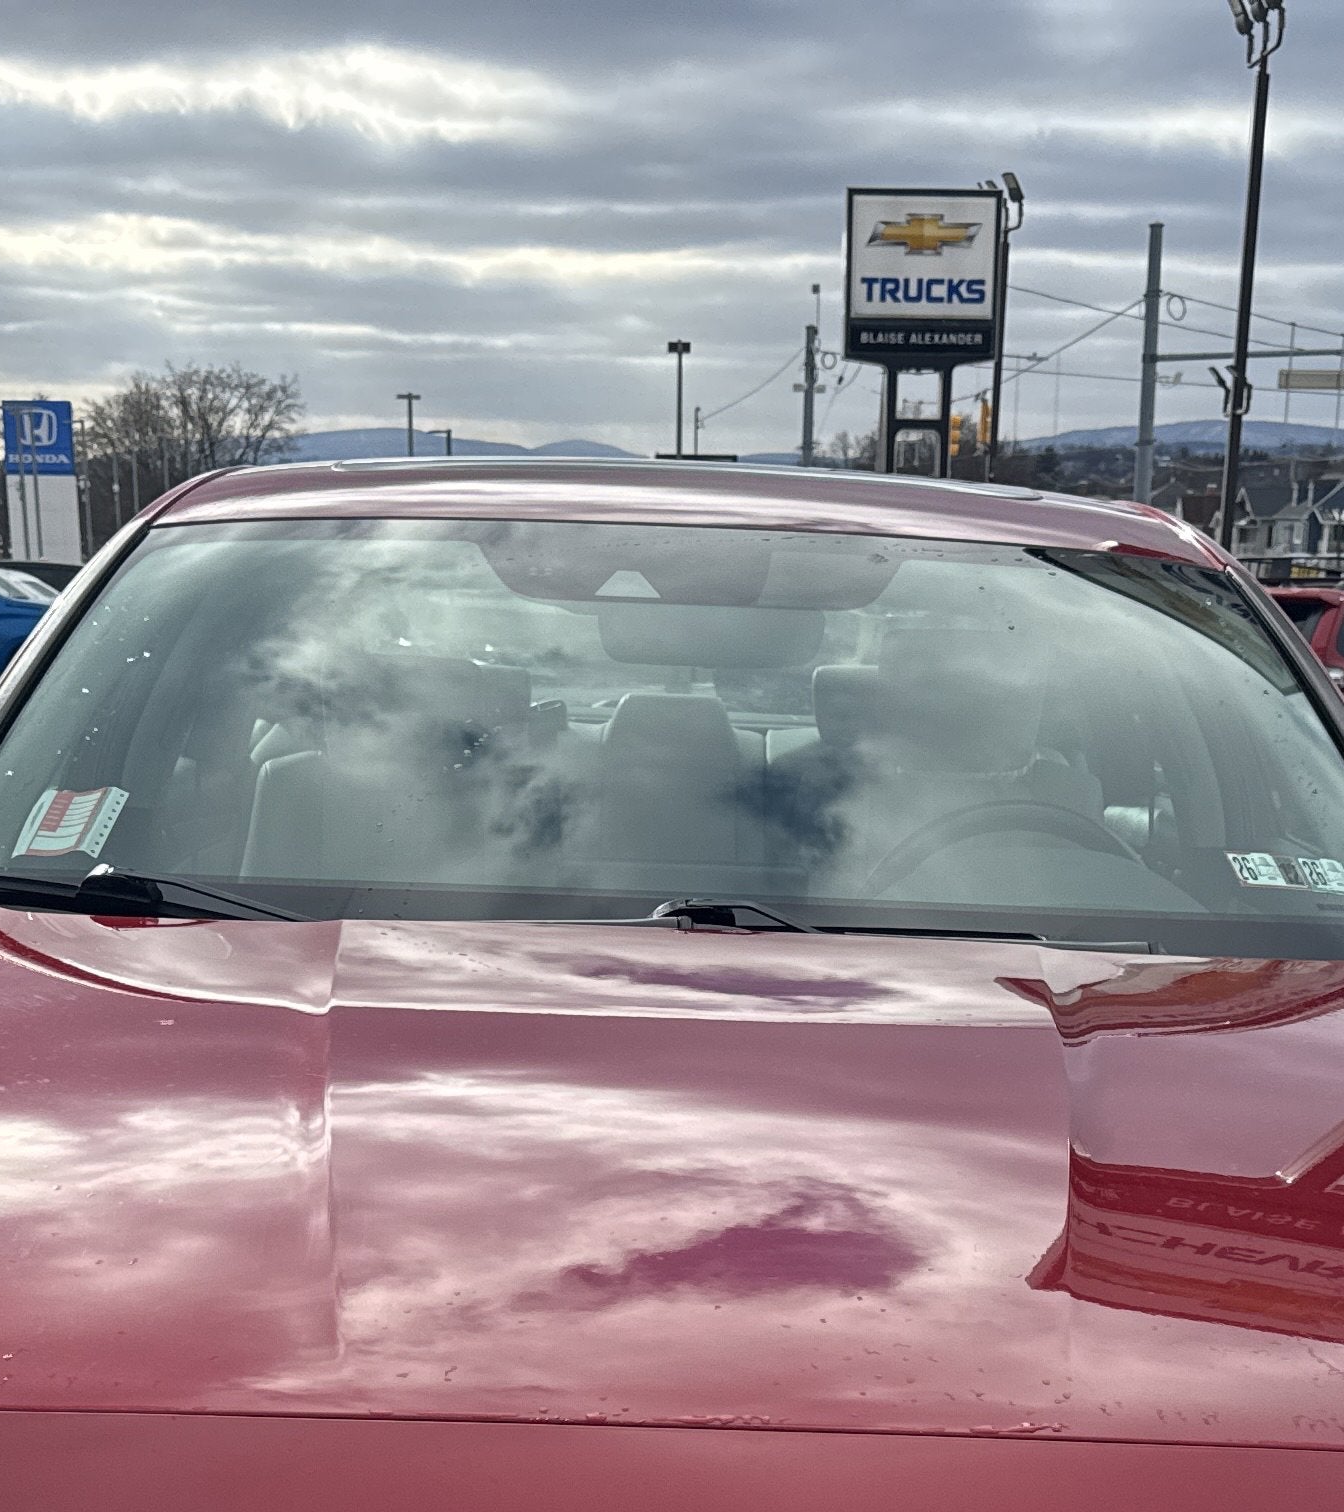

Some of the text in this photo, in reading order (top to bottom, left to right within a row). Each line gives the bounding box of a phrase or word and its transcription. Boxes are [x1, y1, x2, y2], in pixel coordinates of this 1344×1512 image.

[861, 277, 986, 304] TRUCKS
[860, 331, 983, 345] BLAISE ALEXANDER
[7, 453, 71, 464] HONDA
[1232, 856, 1259, 881] 26
[1302, 860, 1328, 886] 26
